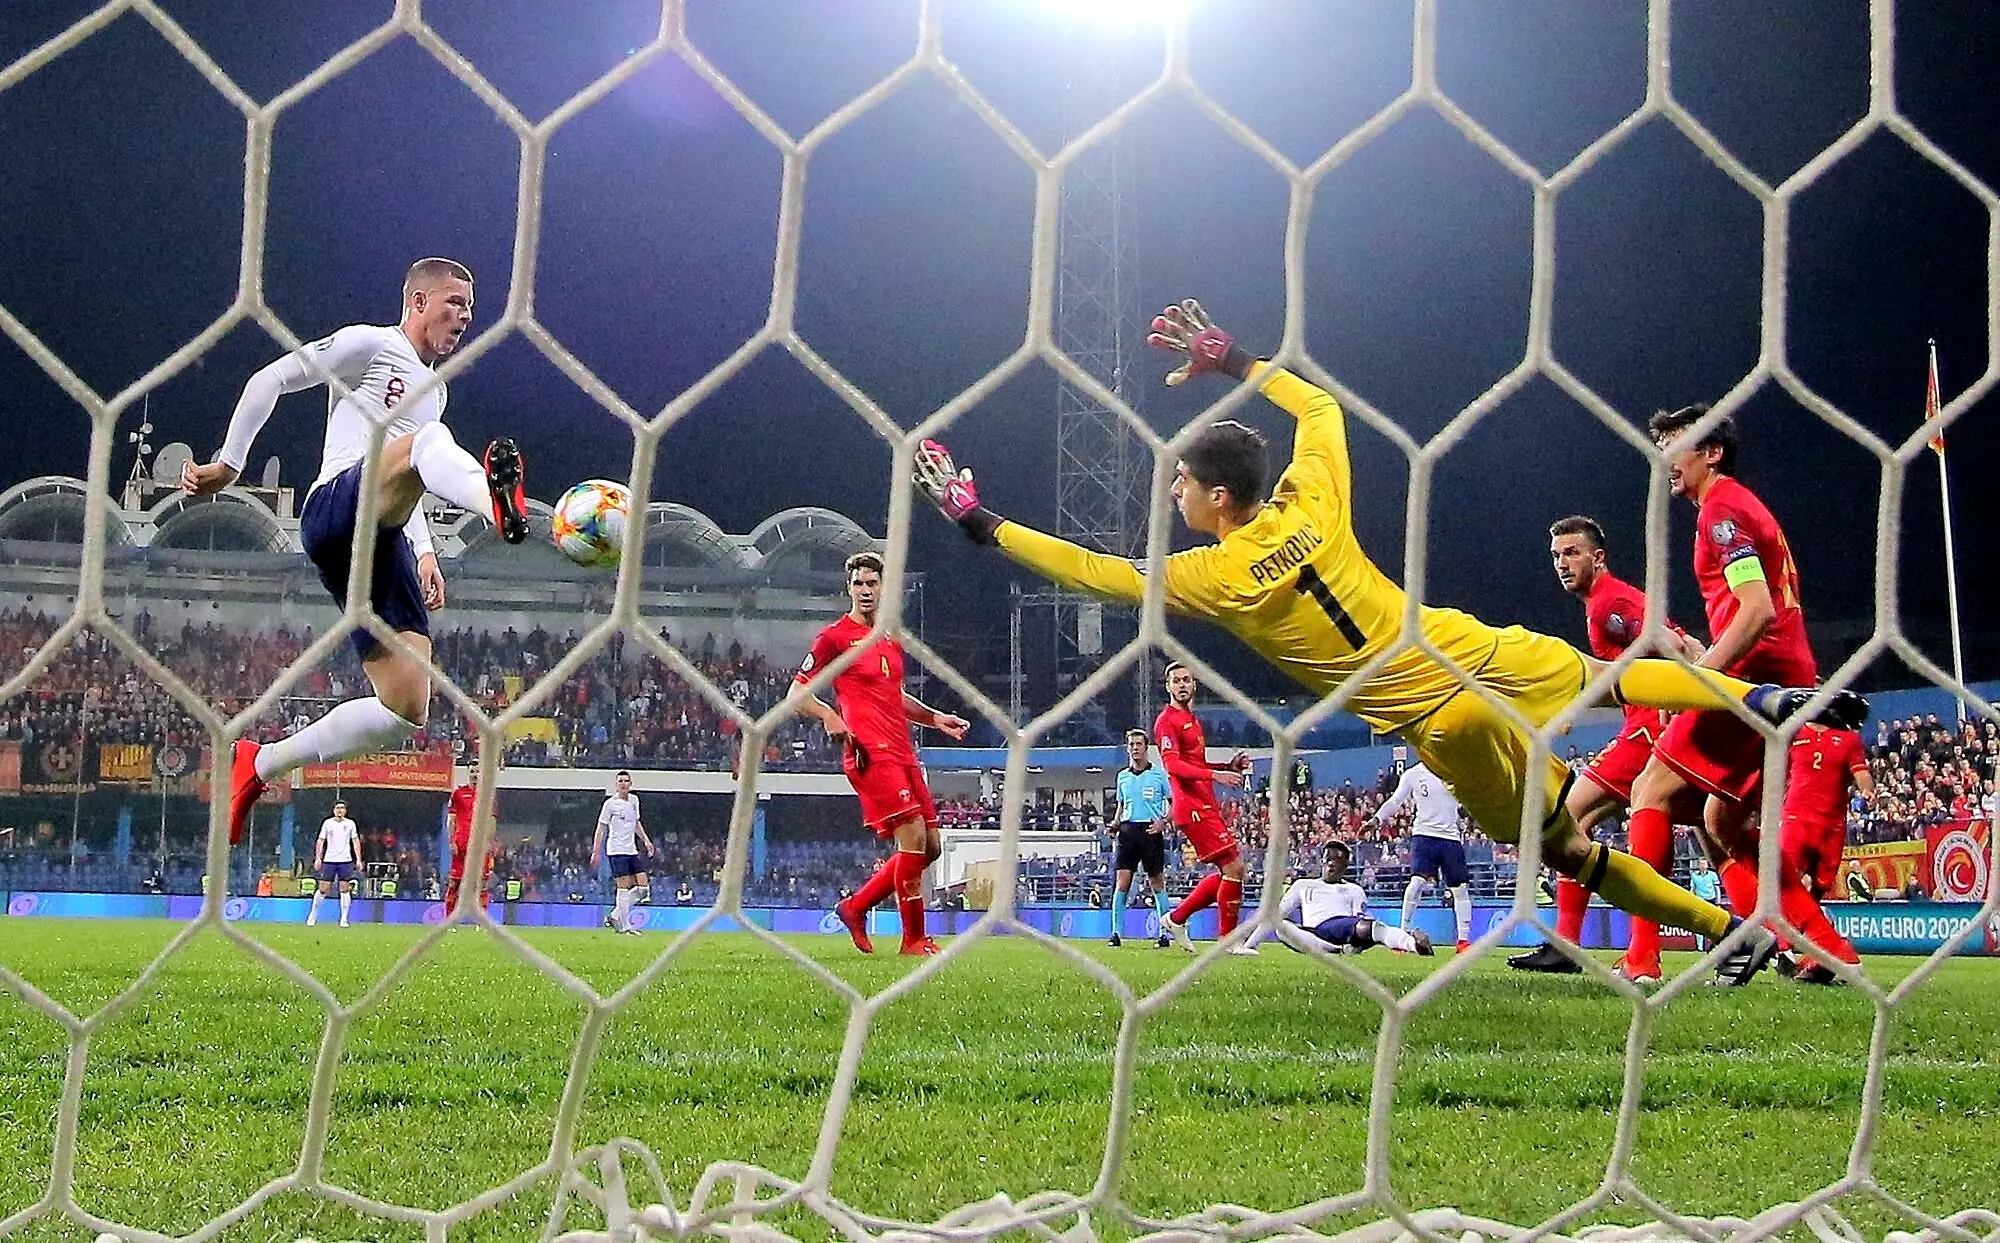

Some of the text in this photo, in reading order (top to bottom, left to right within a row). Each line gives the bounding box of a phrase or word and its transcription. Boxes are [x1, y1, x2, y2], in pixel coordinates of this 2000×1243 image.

[1295, 563, 1368, 652] 1
[881, 655, 890, 678] 4
[1812, 751, 1823, 770] 2
[1243, 774, 1252, 792] A
[1420, 783, 1429, 798] 3
[1838, 915, 1971, 938] UEFA EURO 2020
